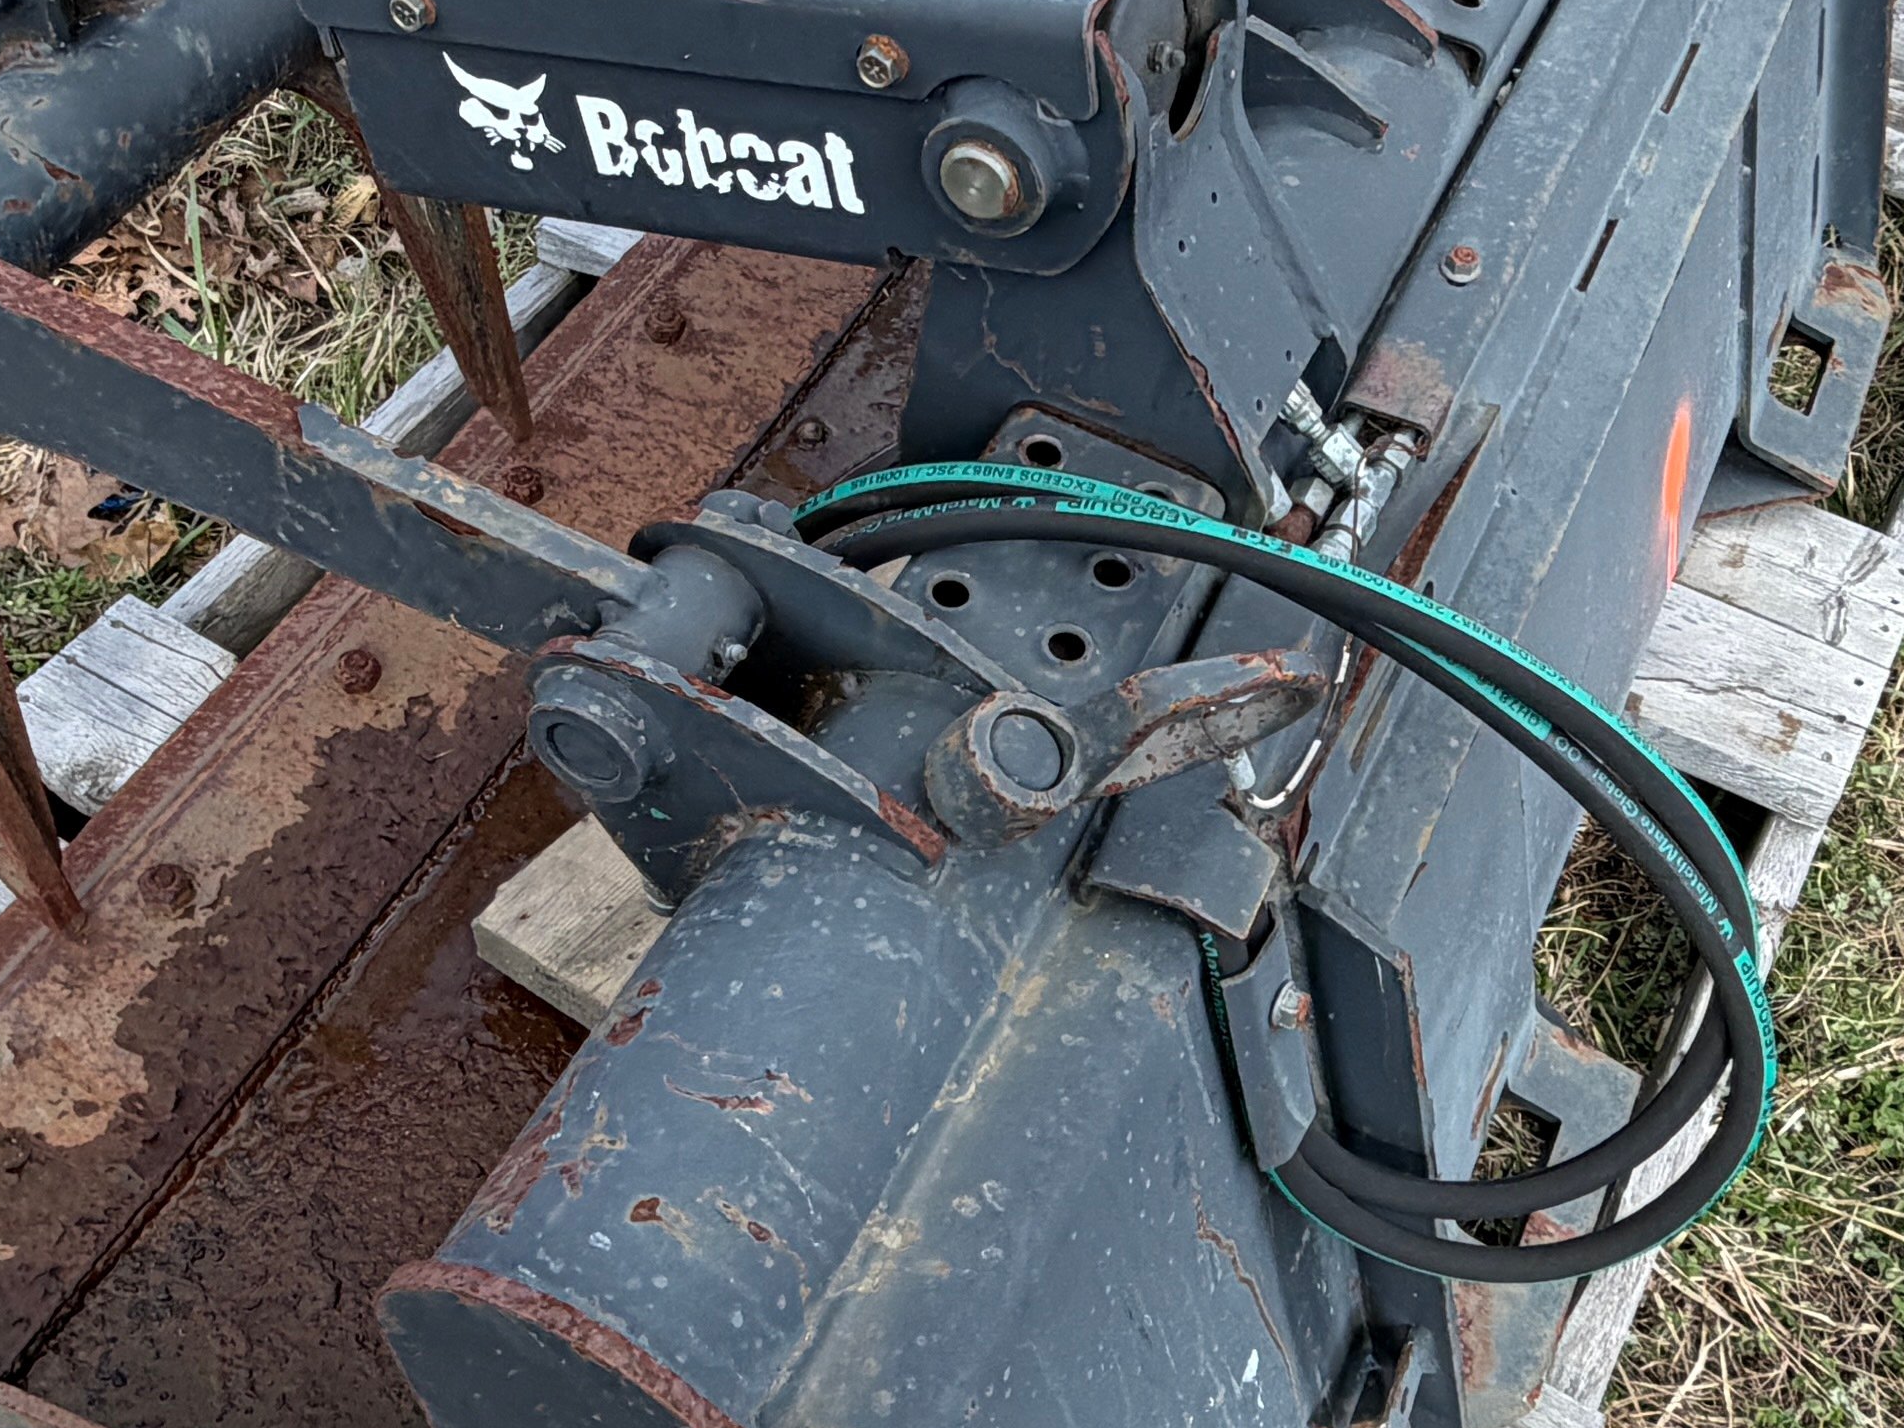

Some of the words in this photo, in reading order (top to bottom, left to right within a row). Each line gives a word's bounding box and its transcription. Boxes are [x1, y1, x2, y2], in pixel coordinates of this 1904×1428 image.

[575, 94, 866, 214] Bobcat
[1019, 468, 1097, 494] EXCEEDS
[1591, 768, 1639, 819] Global
[1739, 960, 1776, 1060] AEROQUIP
